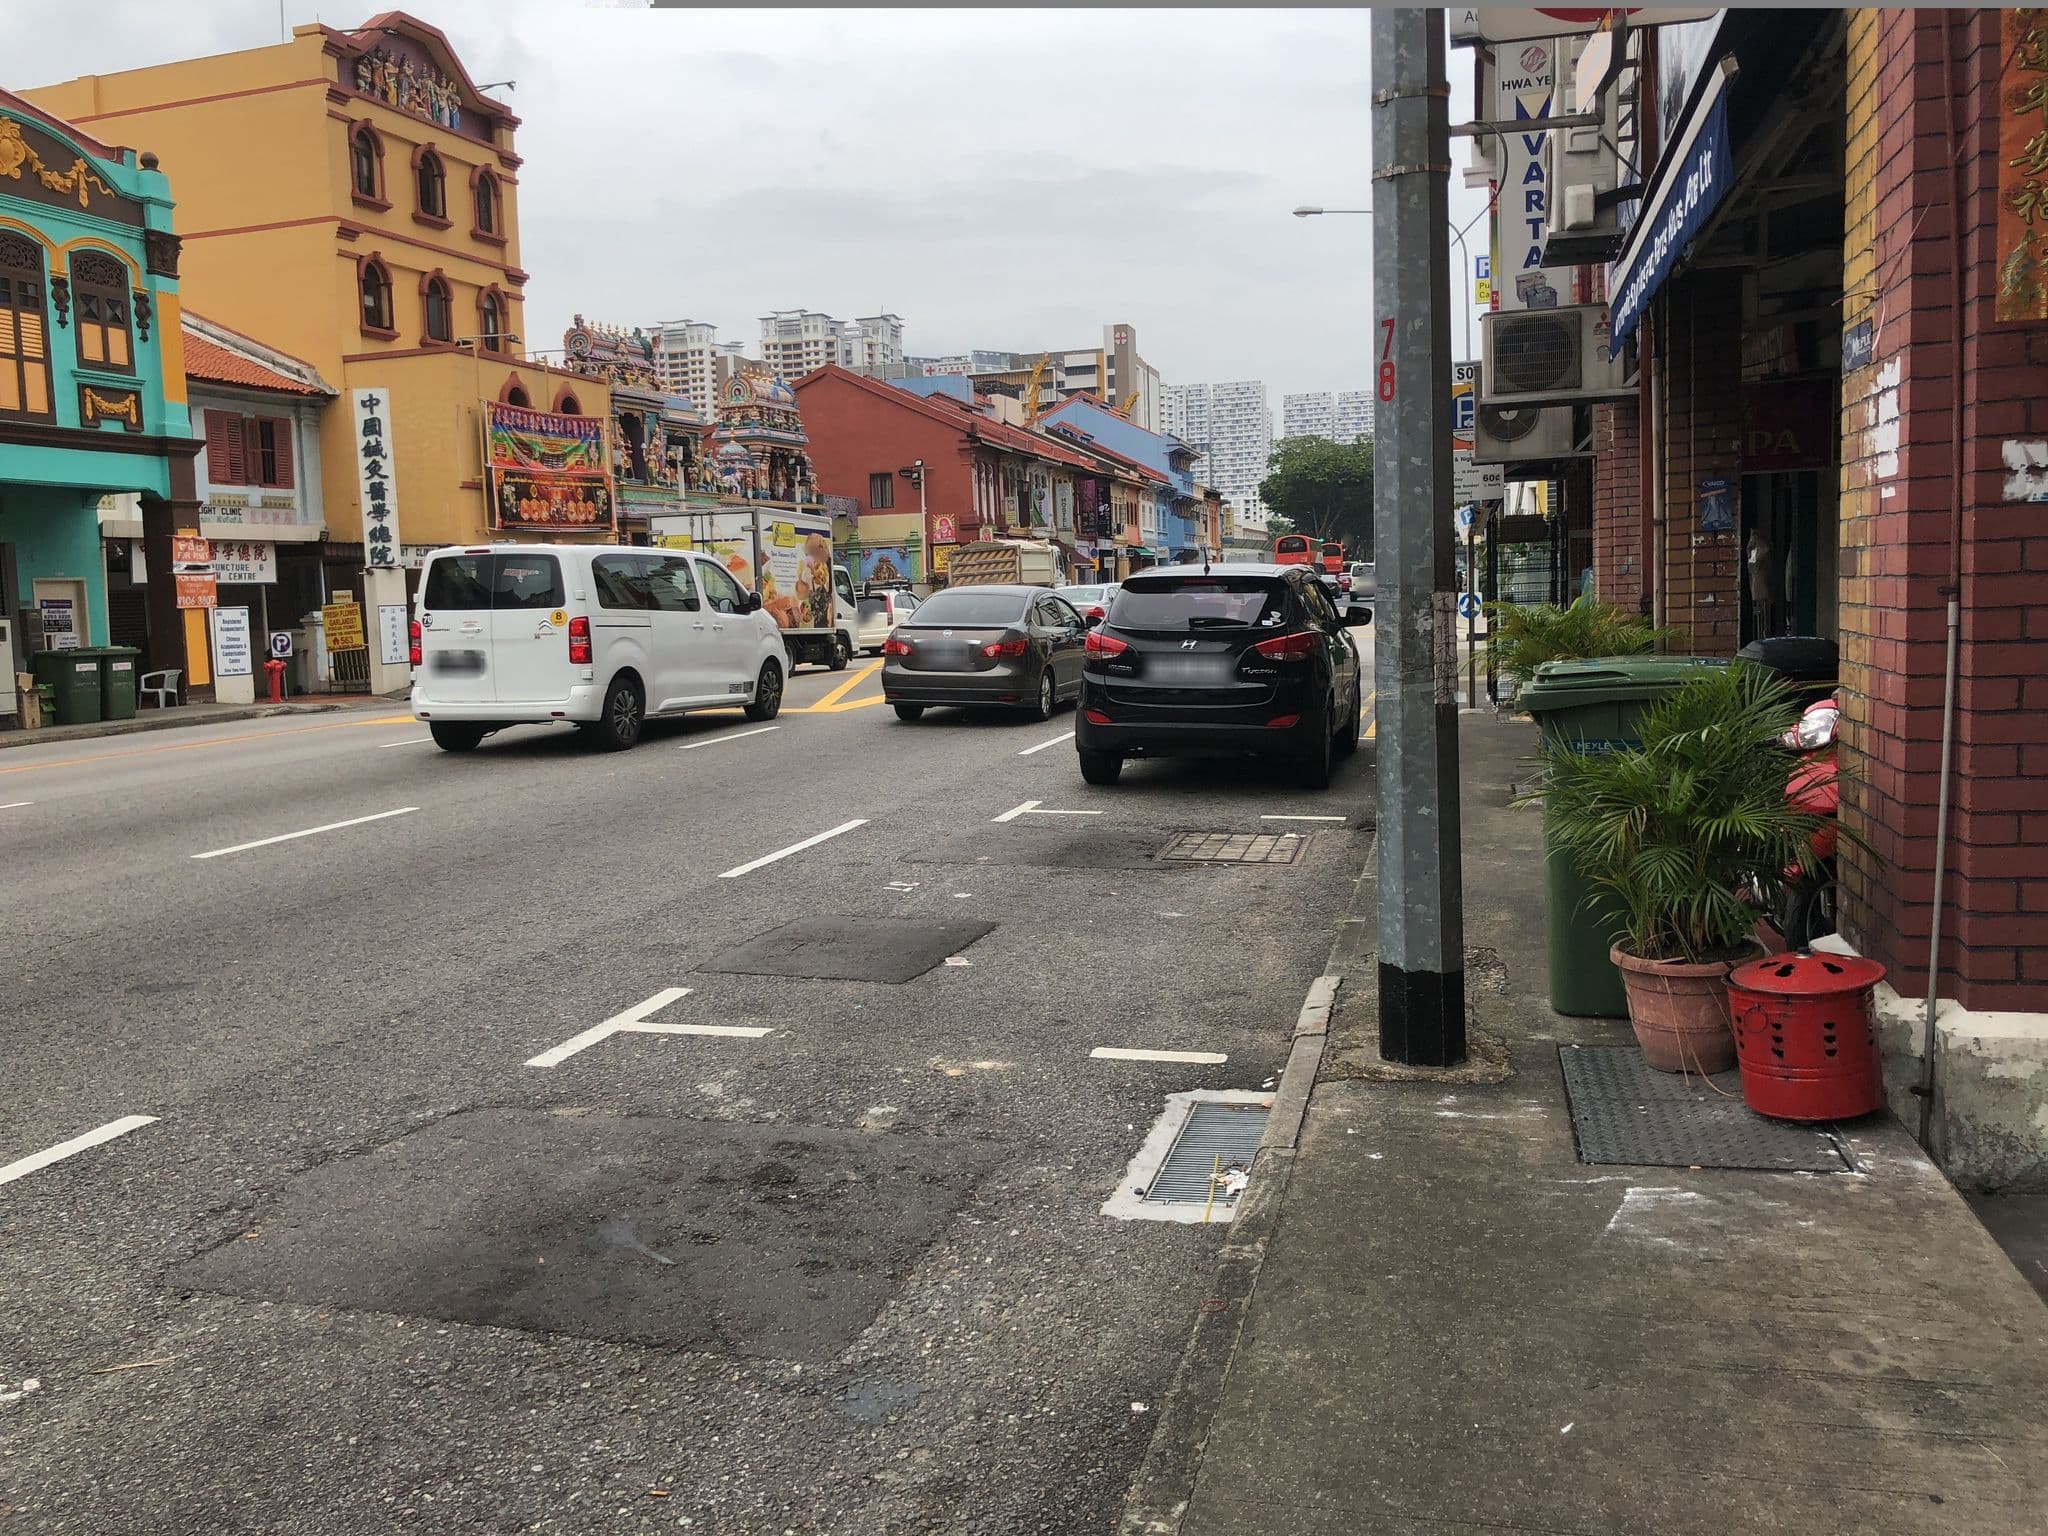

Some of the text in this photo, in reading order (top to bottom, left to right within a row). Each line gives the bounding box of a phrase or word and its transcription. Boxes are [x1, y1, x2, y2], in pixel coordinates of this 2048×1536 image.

[1502, 78, 1532, 91] HWA
[1522, 132, 1547, 269] VARTA
[1379, 318, 1396, 402] 78
[221, 507, 242, 516] CLINIC
[228, 572, 257, 581] CENTRE
[423, 615, 433, 624] 70
